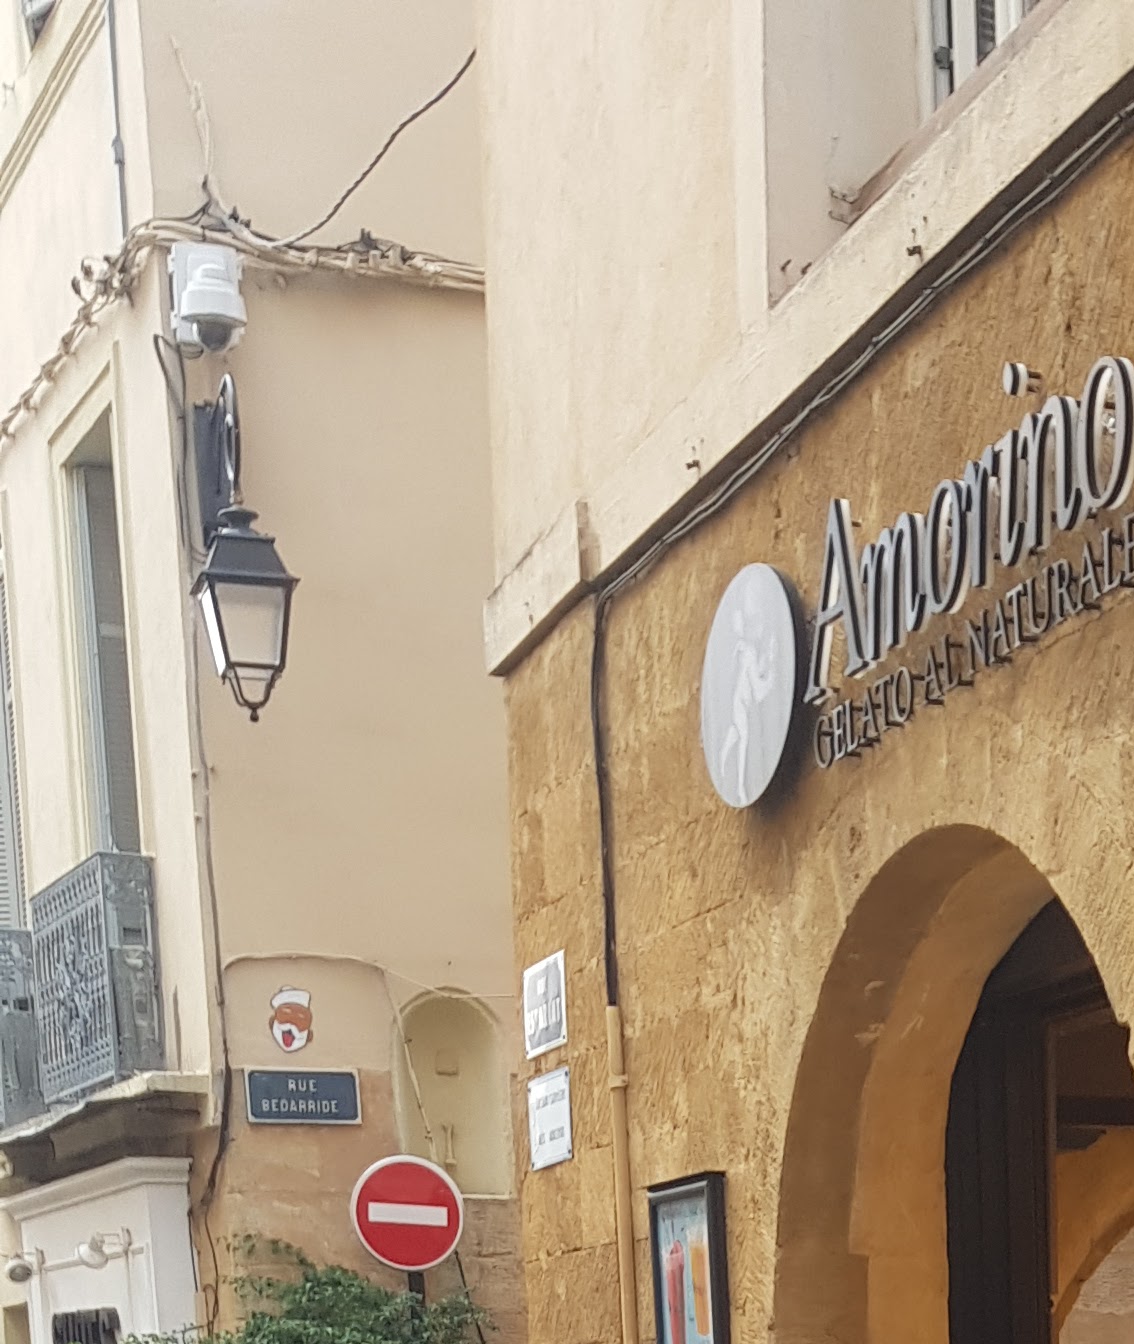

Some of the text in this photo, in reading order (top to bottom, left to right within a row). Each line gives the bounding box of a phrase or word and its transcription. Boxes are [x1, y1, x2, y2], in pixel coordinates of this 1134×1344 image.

[813, 666, 917, 768] GELATO
[923, 634, 974, 704] AL
[287, 1079, 318, 1093] RUE
